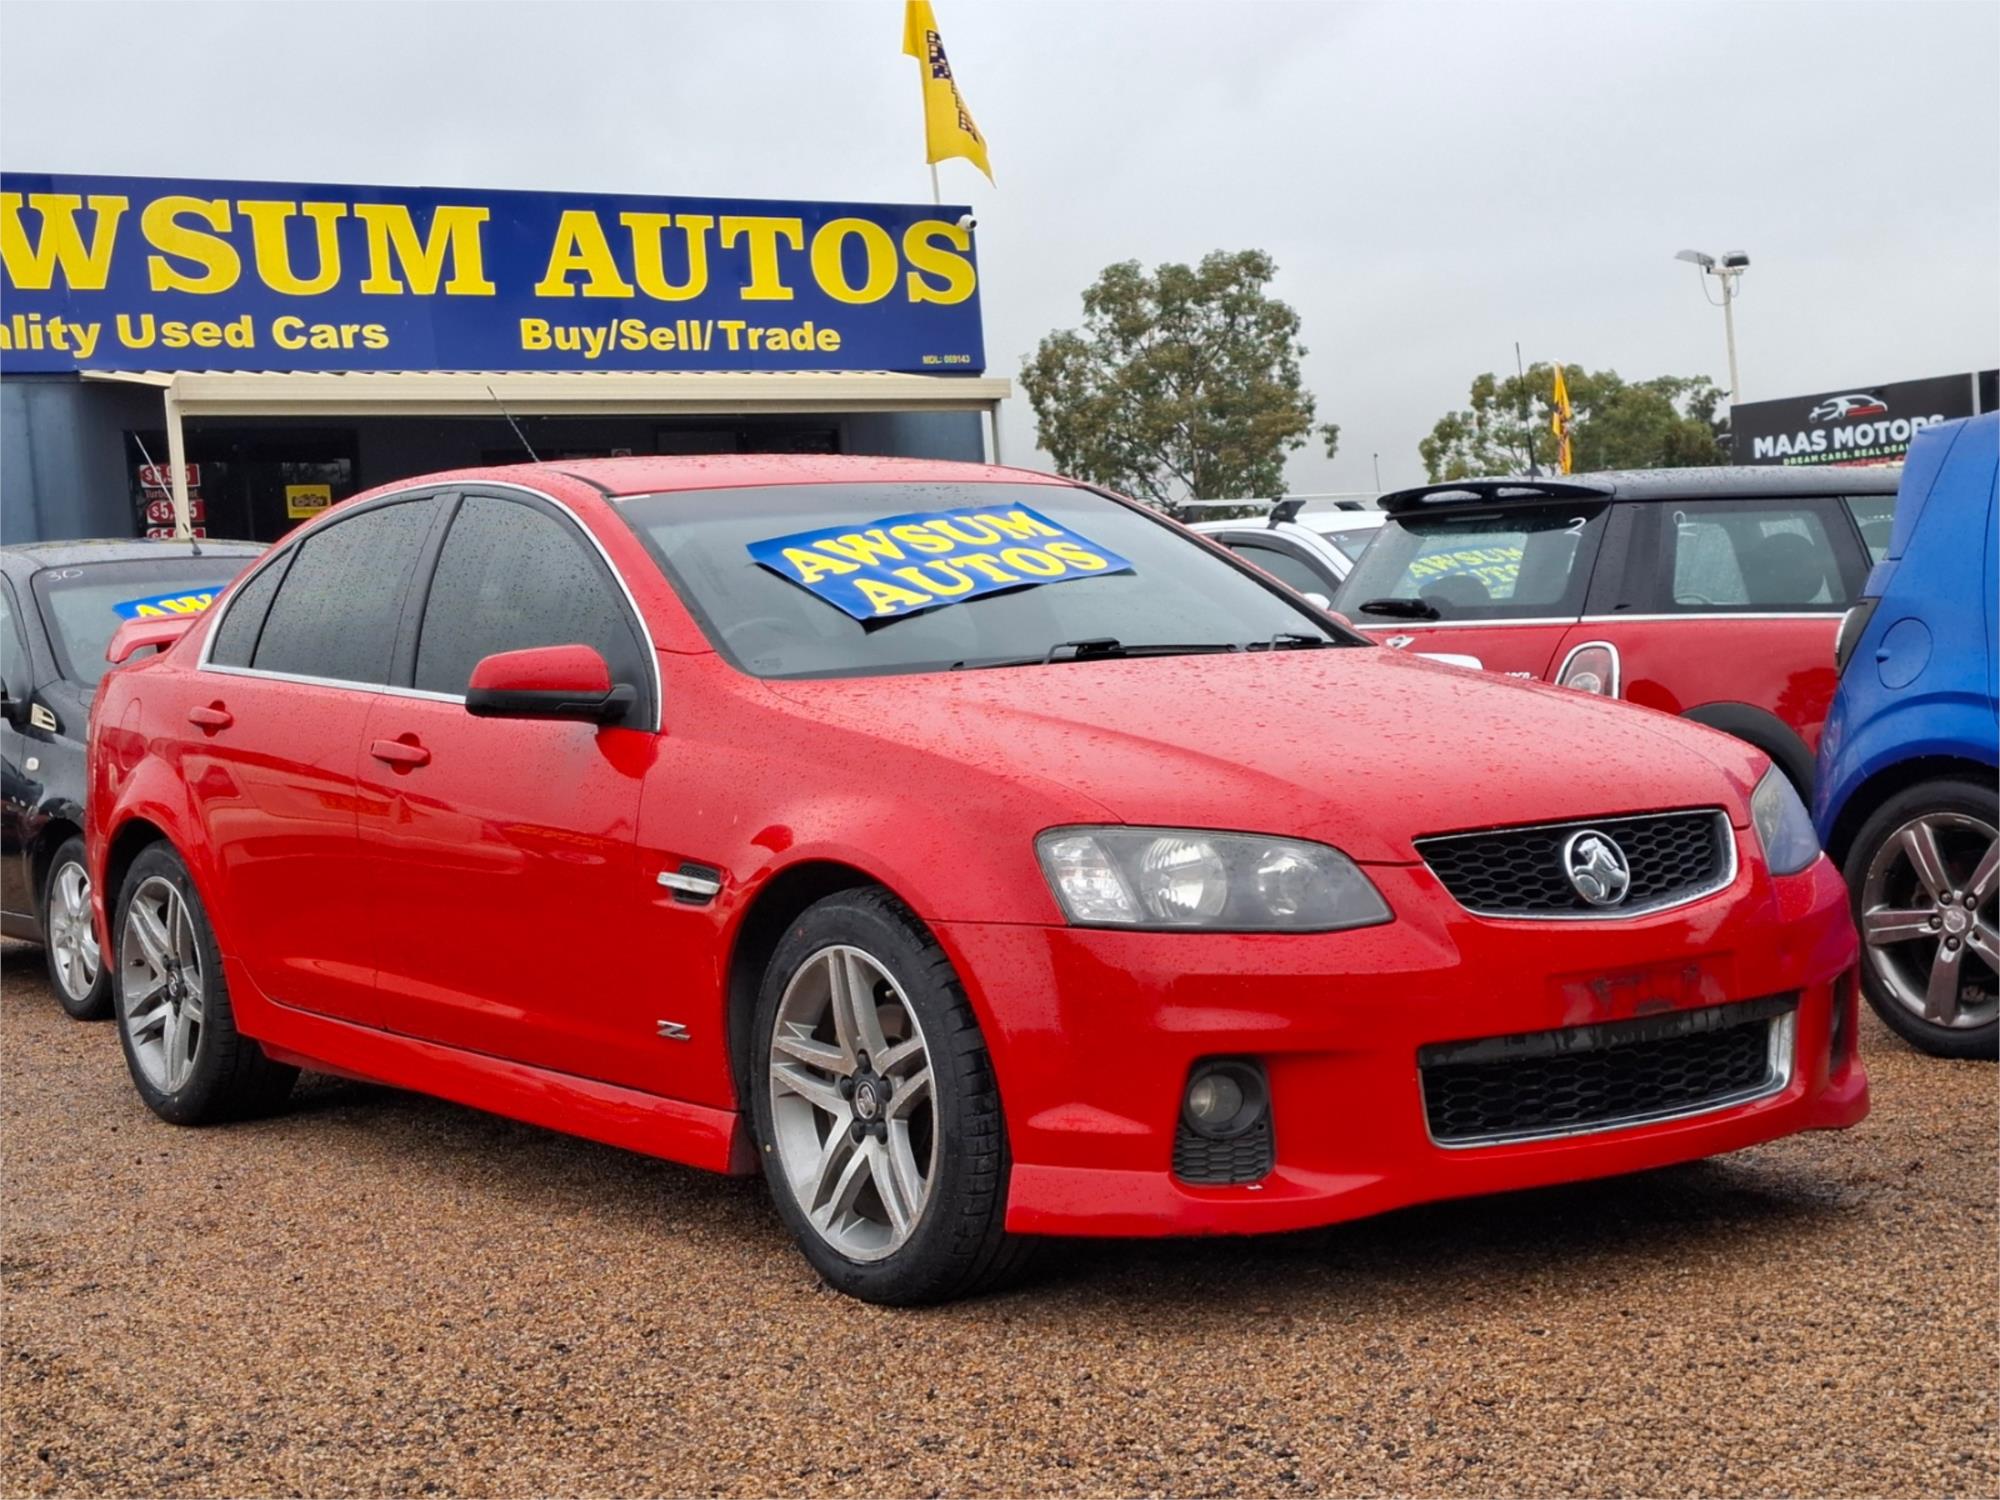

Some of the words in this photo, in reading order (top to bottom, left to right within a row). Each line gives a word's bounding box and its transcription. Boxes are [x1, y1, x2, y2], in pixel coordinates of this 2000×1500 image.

[534, 209, 977, 305] AUTOS
[115, 313, 255, 349] Used
[271, 315, 390, 350] Cars
[519, 318, 842, 358] Buy/Sell/Trade
[1753, 429, 1828, 459] MAAS
[1783, 454, 1818, 466] DREAM
[1854, 447, 1882, 458] REAL
[782, 510, 1064, 583] AWSUM
[852, 541, 1109, 615] AUTOS
